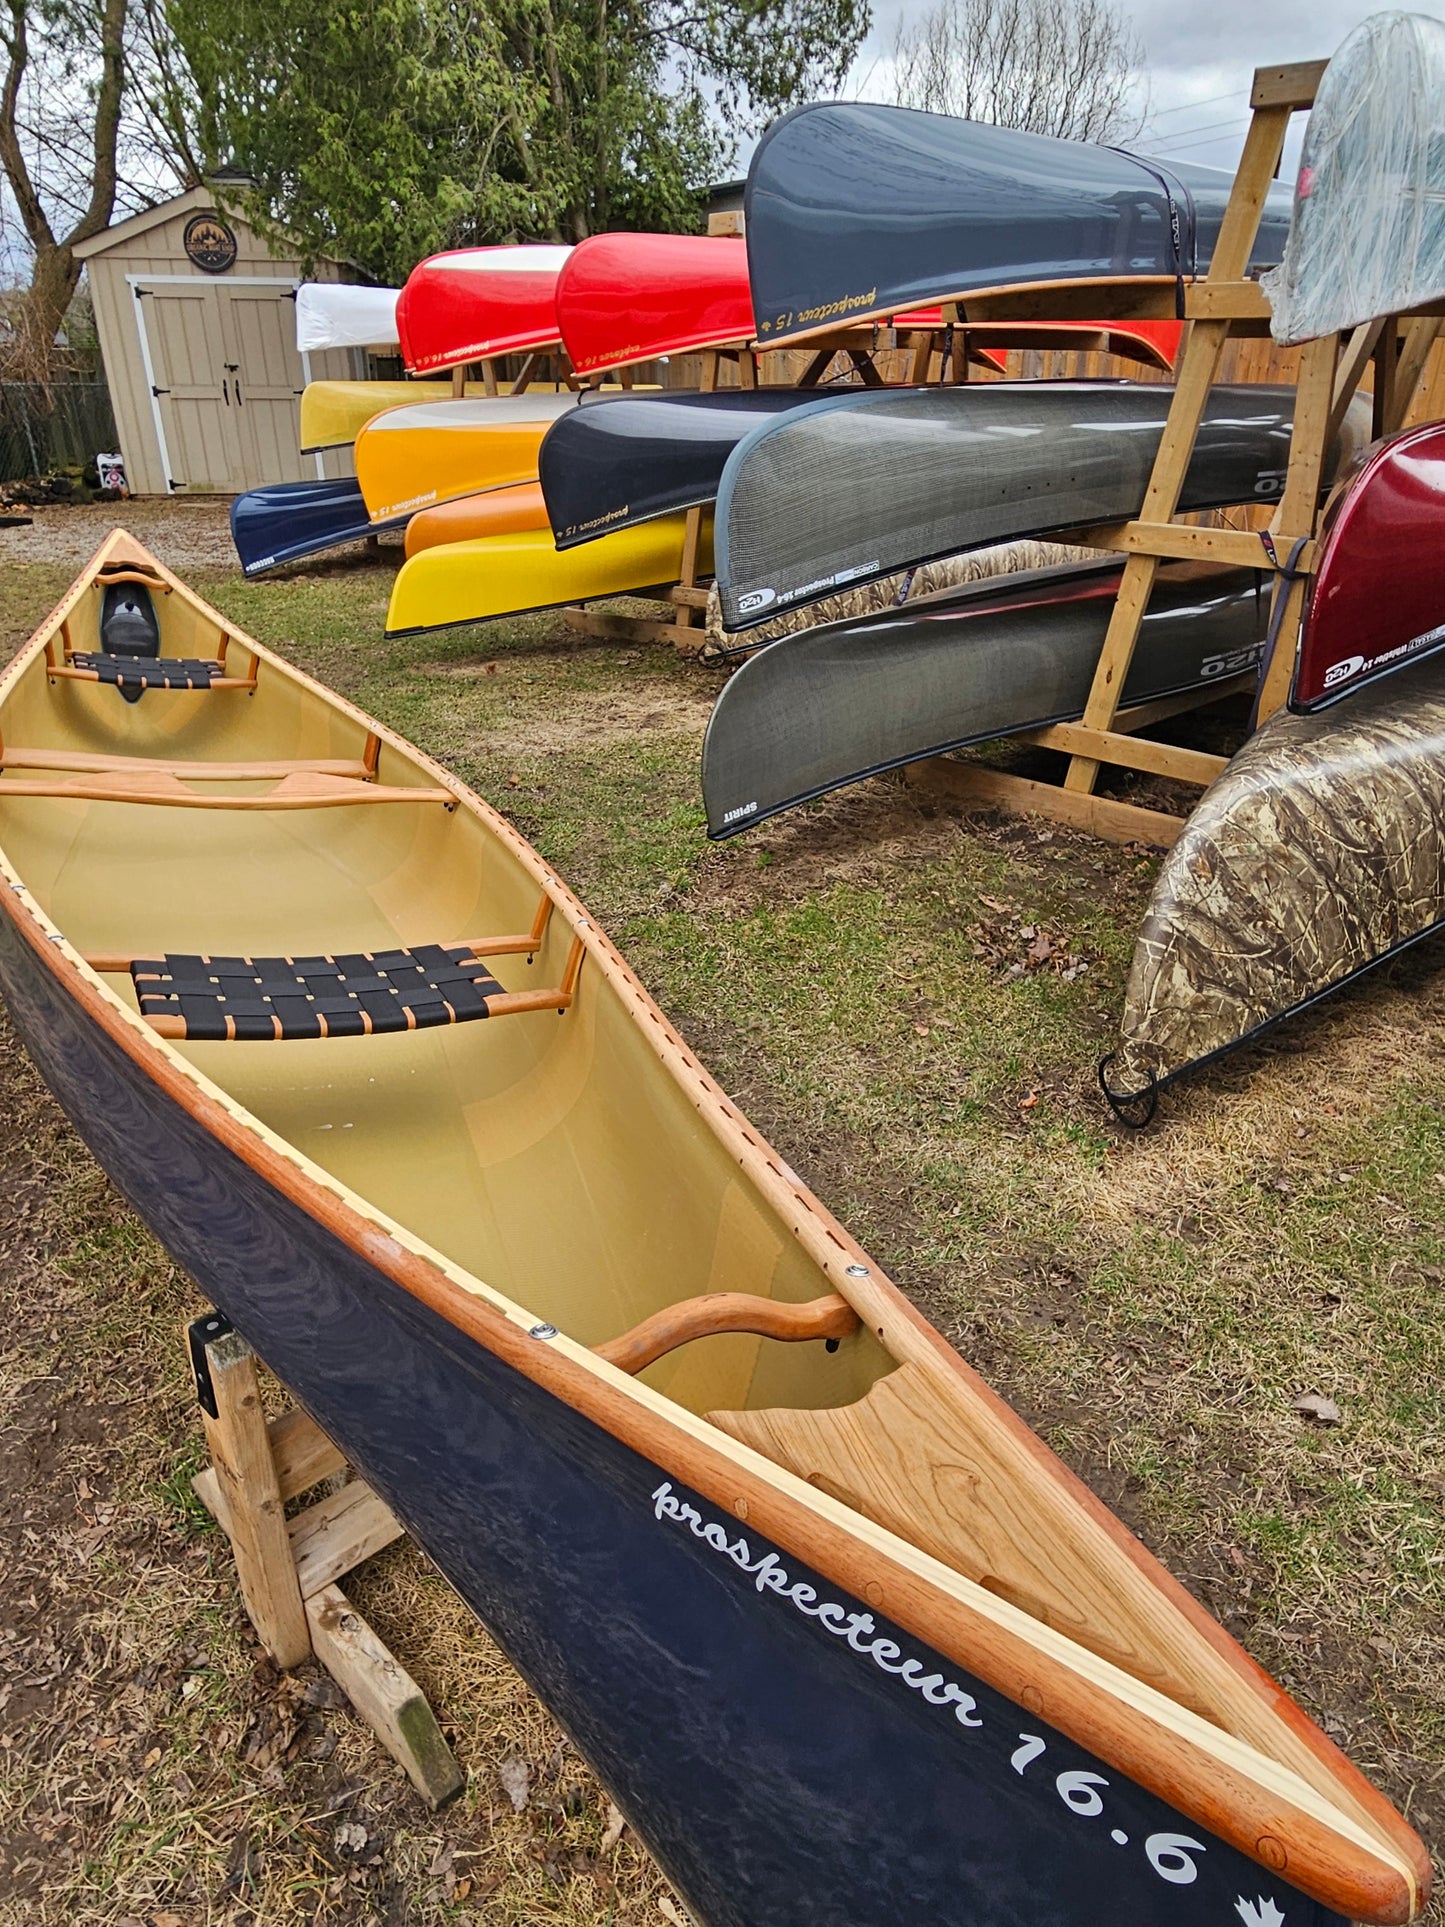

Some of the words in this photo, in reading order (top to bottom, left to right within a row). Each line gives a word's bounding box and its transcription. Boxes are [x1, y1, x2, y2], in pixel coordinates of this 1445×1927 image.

[797, 287, 877, 322] prospecteur
[775, 312, 793, 331] 15
[585, 356, 597, 367] 16
[379, 506, 390, 516] 15
[565, 525, 577, 537] 15
[740, 596, 761, 610] H2O
[1362, 659, 1374, 671] 14
[1325, 666, 1349, 682] H2O
[723, 801, 758, 823] SPIRIT
[652, 1482, 983, 1727] prospecteur
[1011, 1733, 1207, 1884] 16.6
